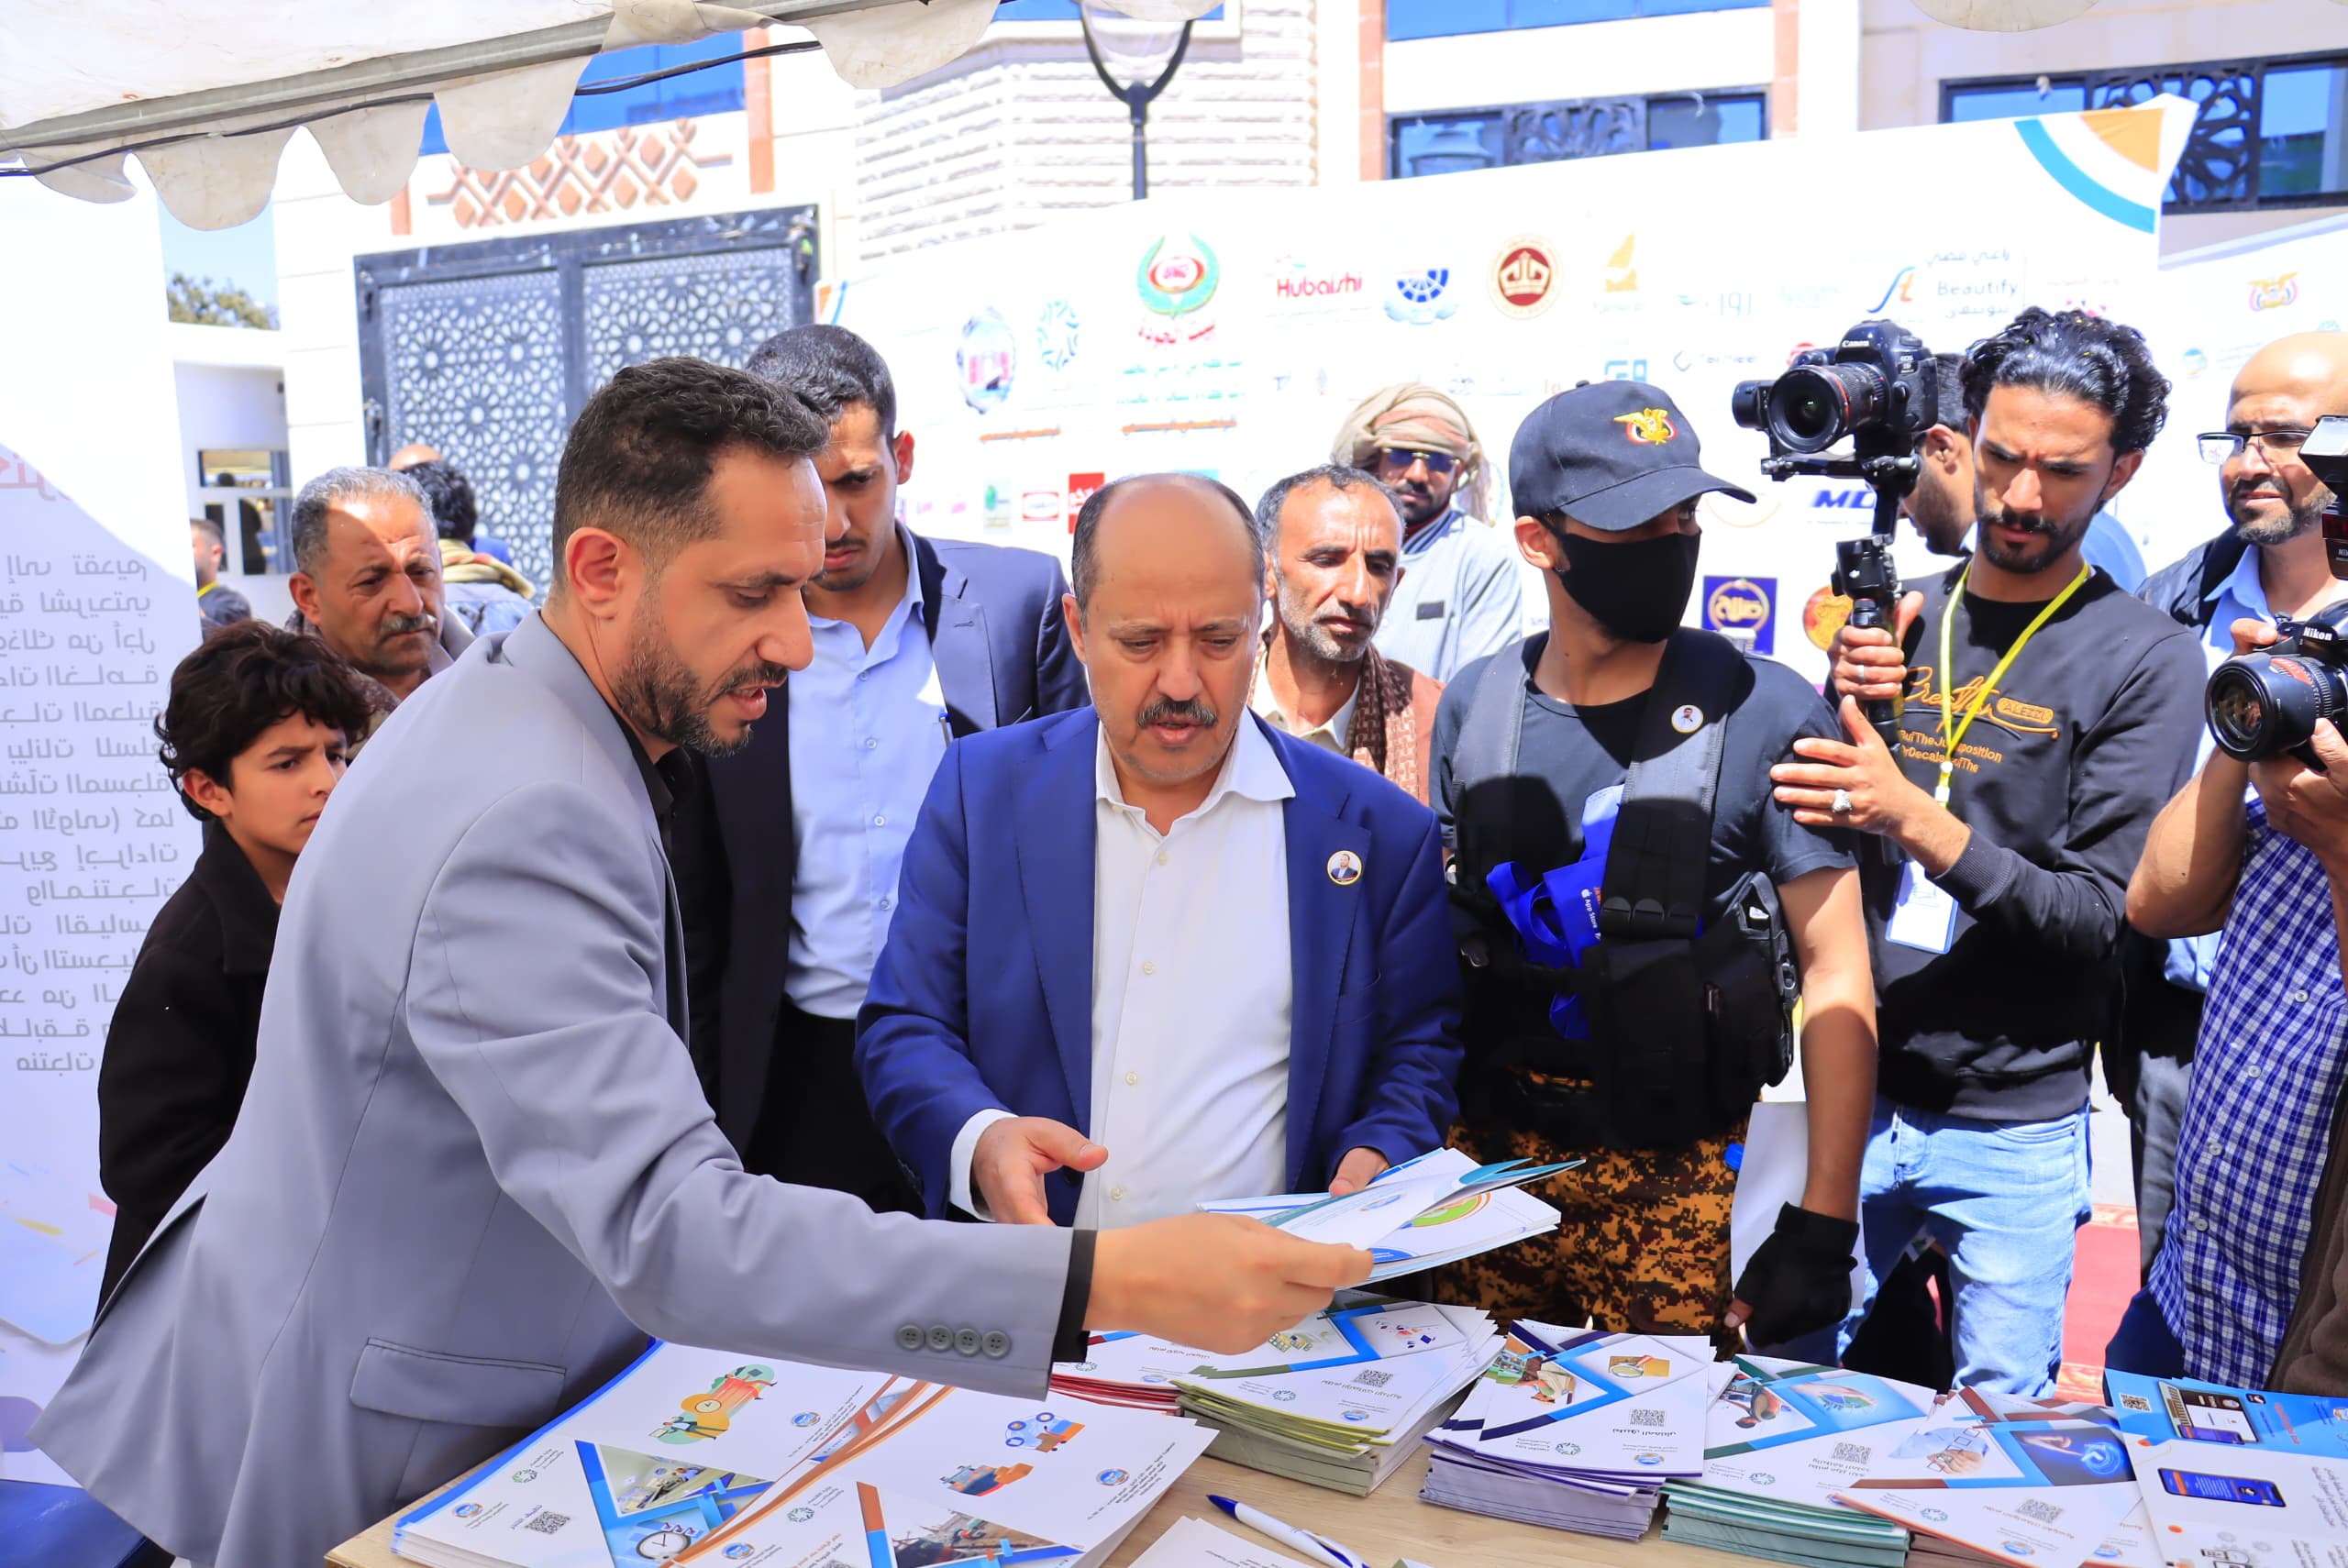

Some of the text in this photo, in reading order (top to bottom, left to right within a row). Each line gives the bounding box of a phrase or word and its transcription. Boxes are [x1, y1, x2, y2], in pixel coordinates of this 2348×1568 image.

[1276, 271, 1363, 298] Hubaishi
[1937, 279, 2018, 297] Beautify
[2303, 626, 2332, 642] Nikon
